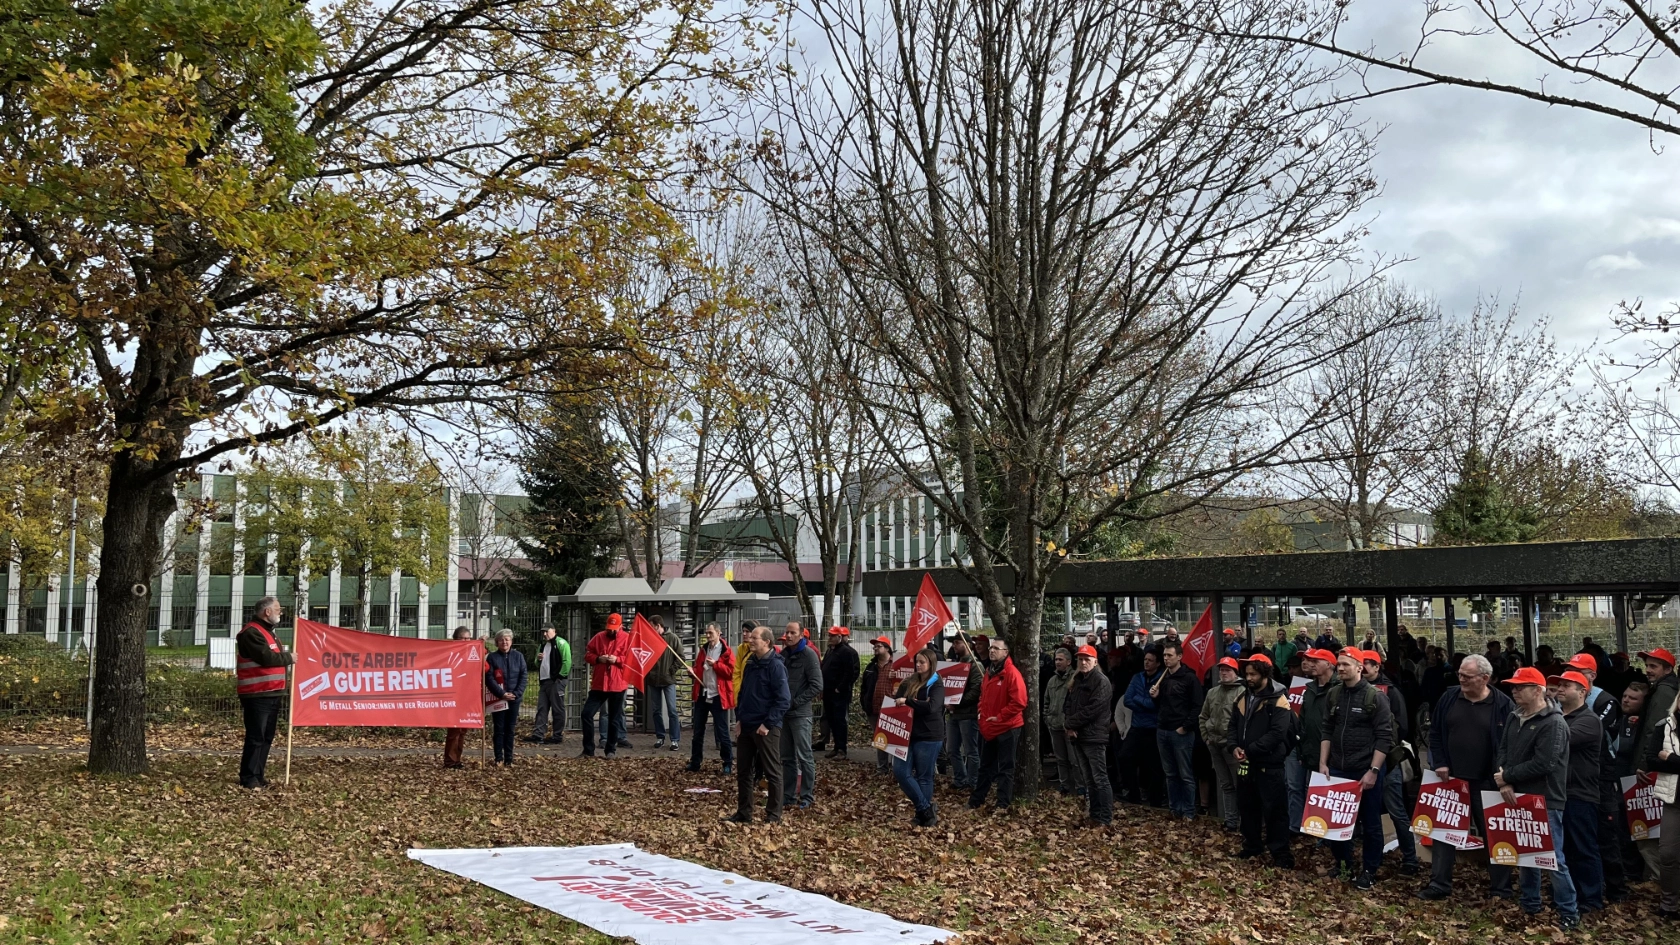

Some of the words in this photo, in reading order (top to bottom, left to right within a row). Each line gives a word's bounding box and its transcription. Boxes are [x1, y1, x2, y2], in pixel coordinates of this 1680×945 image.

[321, 652, 359, 668] GUTE
[363, 652, 417, 668] ARBEIT
[334, 669, 385, 693] GUTE
[388, 667, 453, 691] RENTE
[319, 701, 328, 710] IG
[329, 701, 352, 710] METALL
[417, 700, 439, 709] REGION
[440, 699, 457, 708] LOHR
[878, 719, 910, 740] VERDIENT!
[1327, 789, 1357, 802] DAFÜR
[1435, 787, 1459, 802] DAFÜR
[1635, 785, 1656, 797] DAFÜ
[1418, 792, 1470, 817] STREITEN
[1331, 811, 1354, 825] WIR
[1436, 808, 1461, 828] WIR
[1504, 807, 1533, 821] DAFÜR
[1309, 820, 1322, 829] 8%
[1417, 819, 1428, 828] 8%
[1487, 817, 1549, 835] STREITEN
[1515, 832, 1543, 849] WIR
[1497, 848, 1511, 856] 8%
[693, 891, 798, 920] MACHT
[790, 920, 864, 935] MIT
